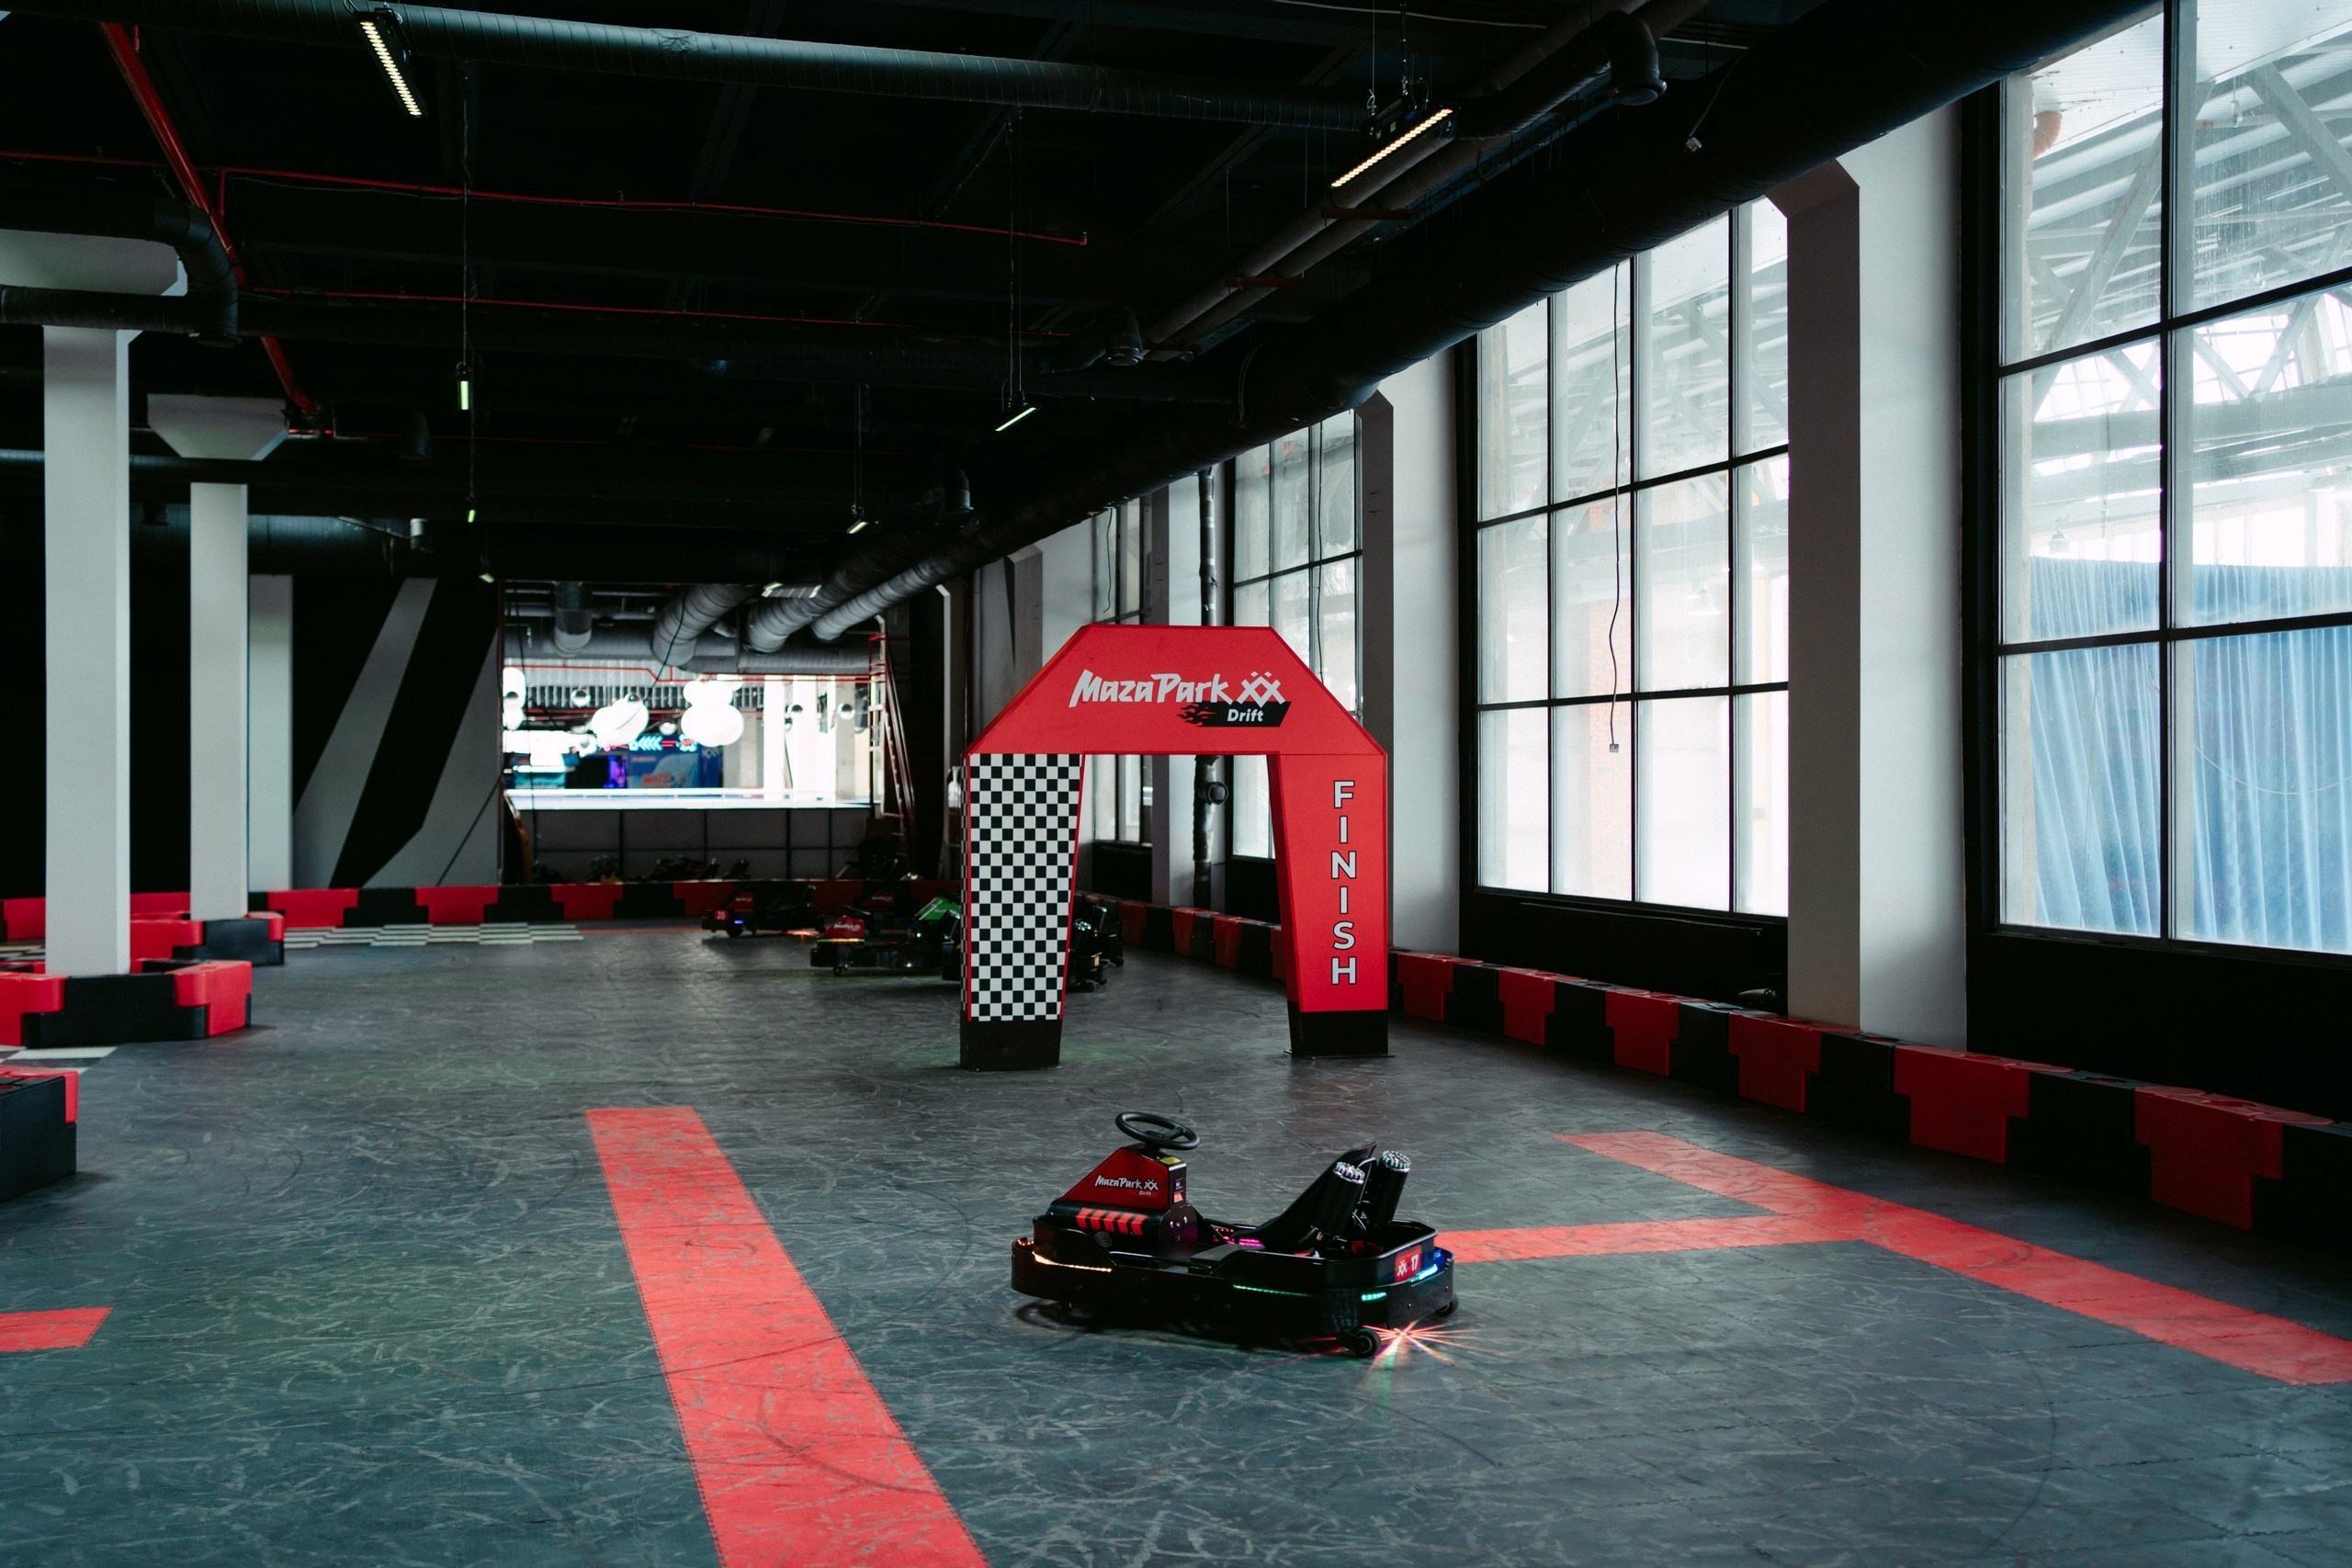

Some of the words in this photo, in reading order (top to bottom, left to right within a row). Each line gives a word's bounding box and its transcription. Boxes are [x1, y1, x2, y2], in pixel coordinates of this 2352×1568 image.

[1069, 669, 1233, 708] MazaPark
[1227, 708, 1264, 723] Drift
[1331, 780, 1357, 985] FINISH
[1094, 1175, 1143, 1190] MazaPark
[1410, 1254, 1419, 1271] 17
